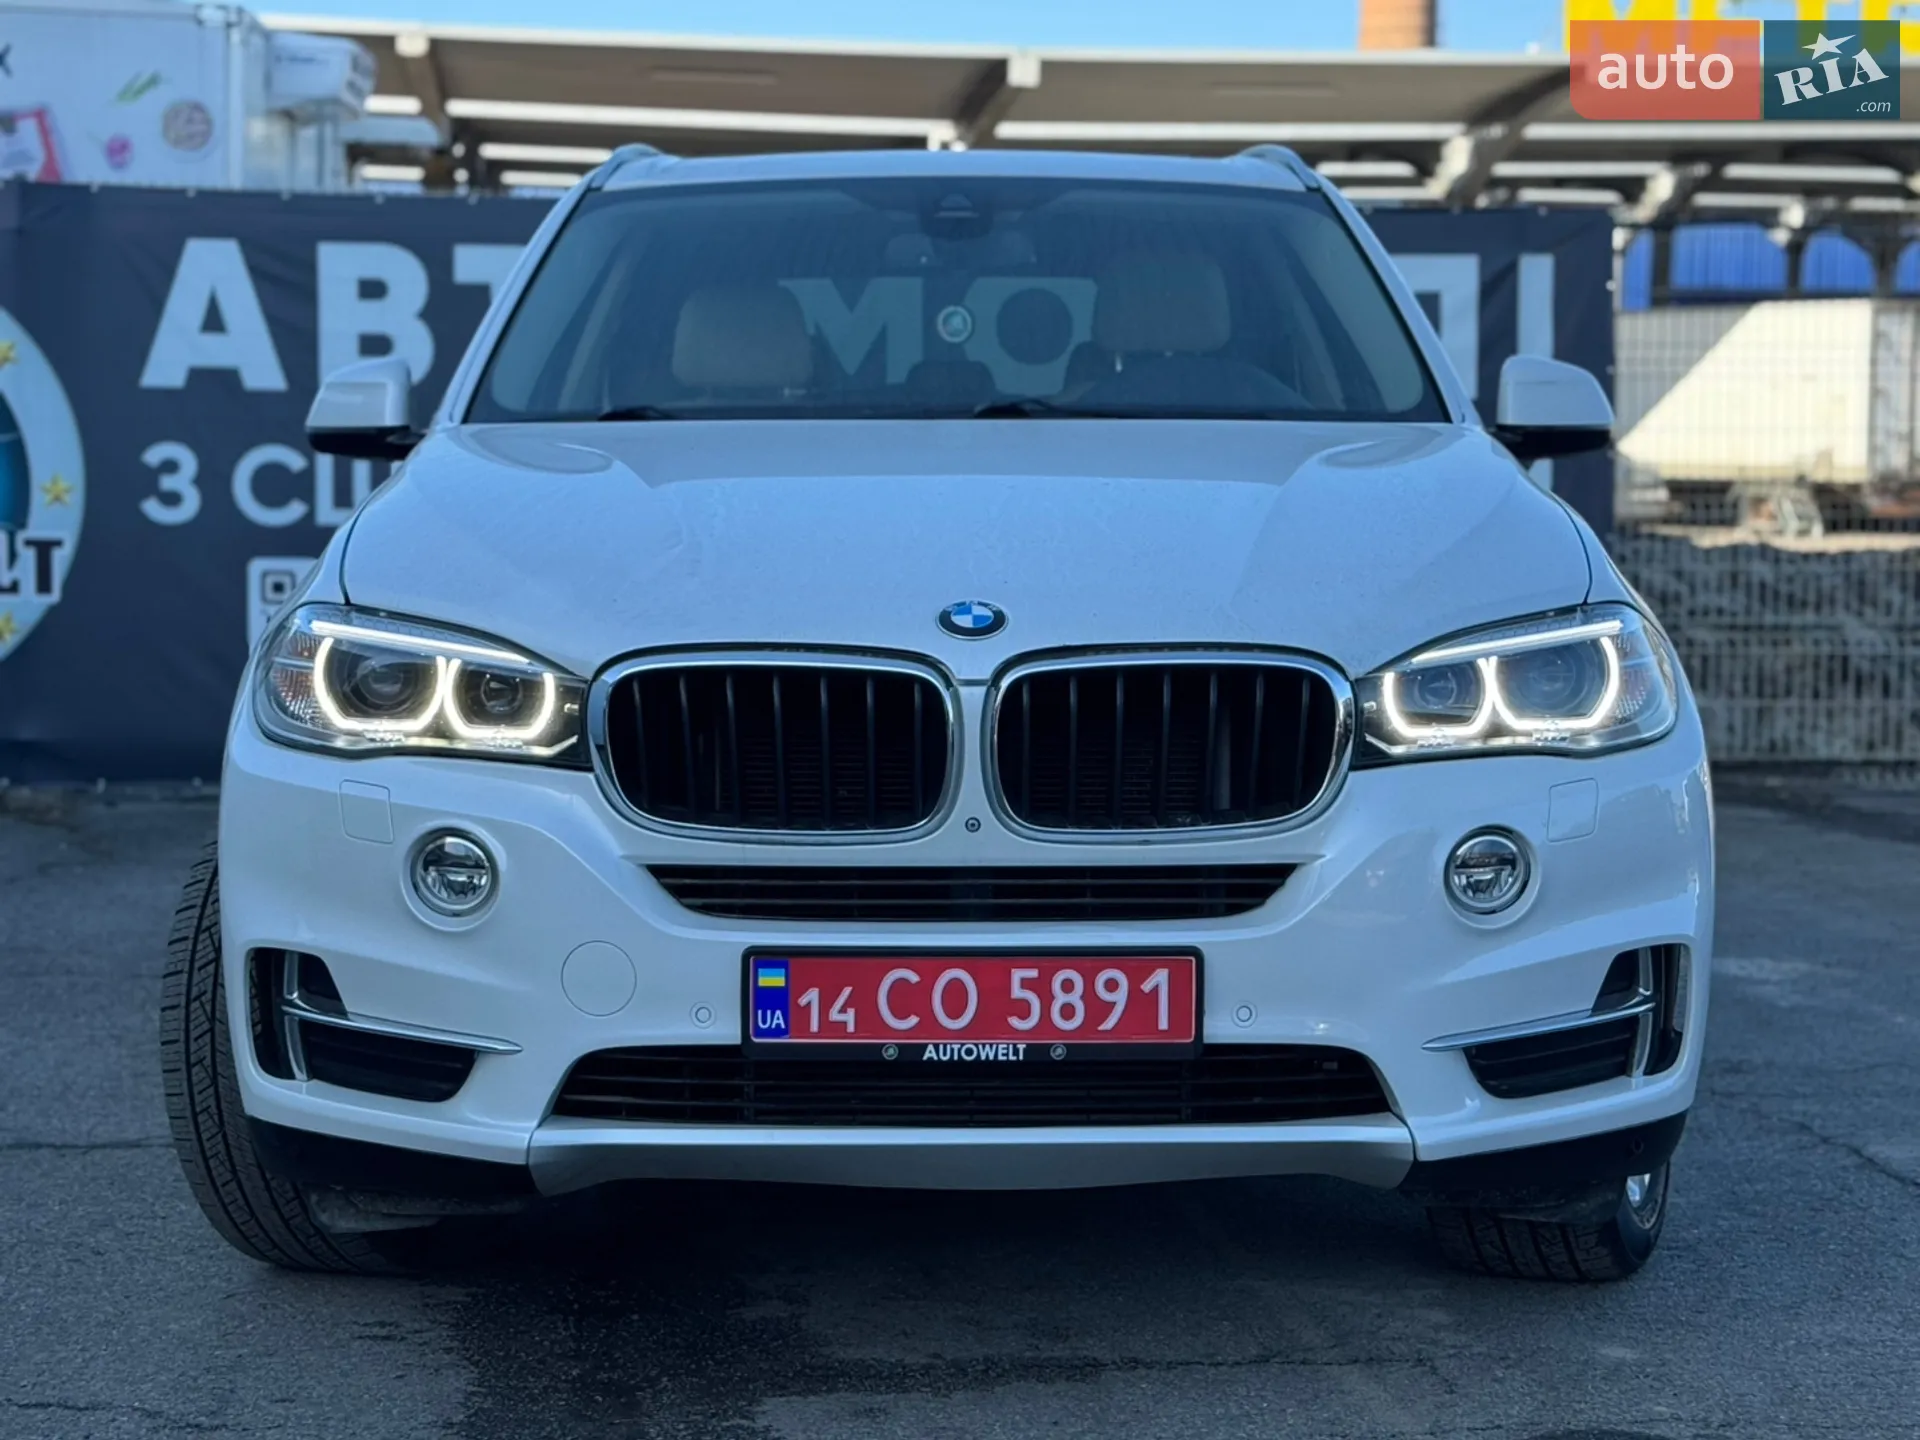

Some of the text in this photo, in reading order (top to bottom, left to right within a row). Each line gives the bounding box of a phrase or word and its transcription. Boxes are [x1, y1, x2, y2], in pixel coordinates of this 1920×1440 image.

[757, 967, 1170, 1033] UA 14 CO 5891
[922, 1043, 1027, 1062] AUTOWELT
